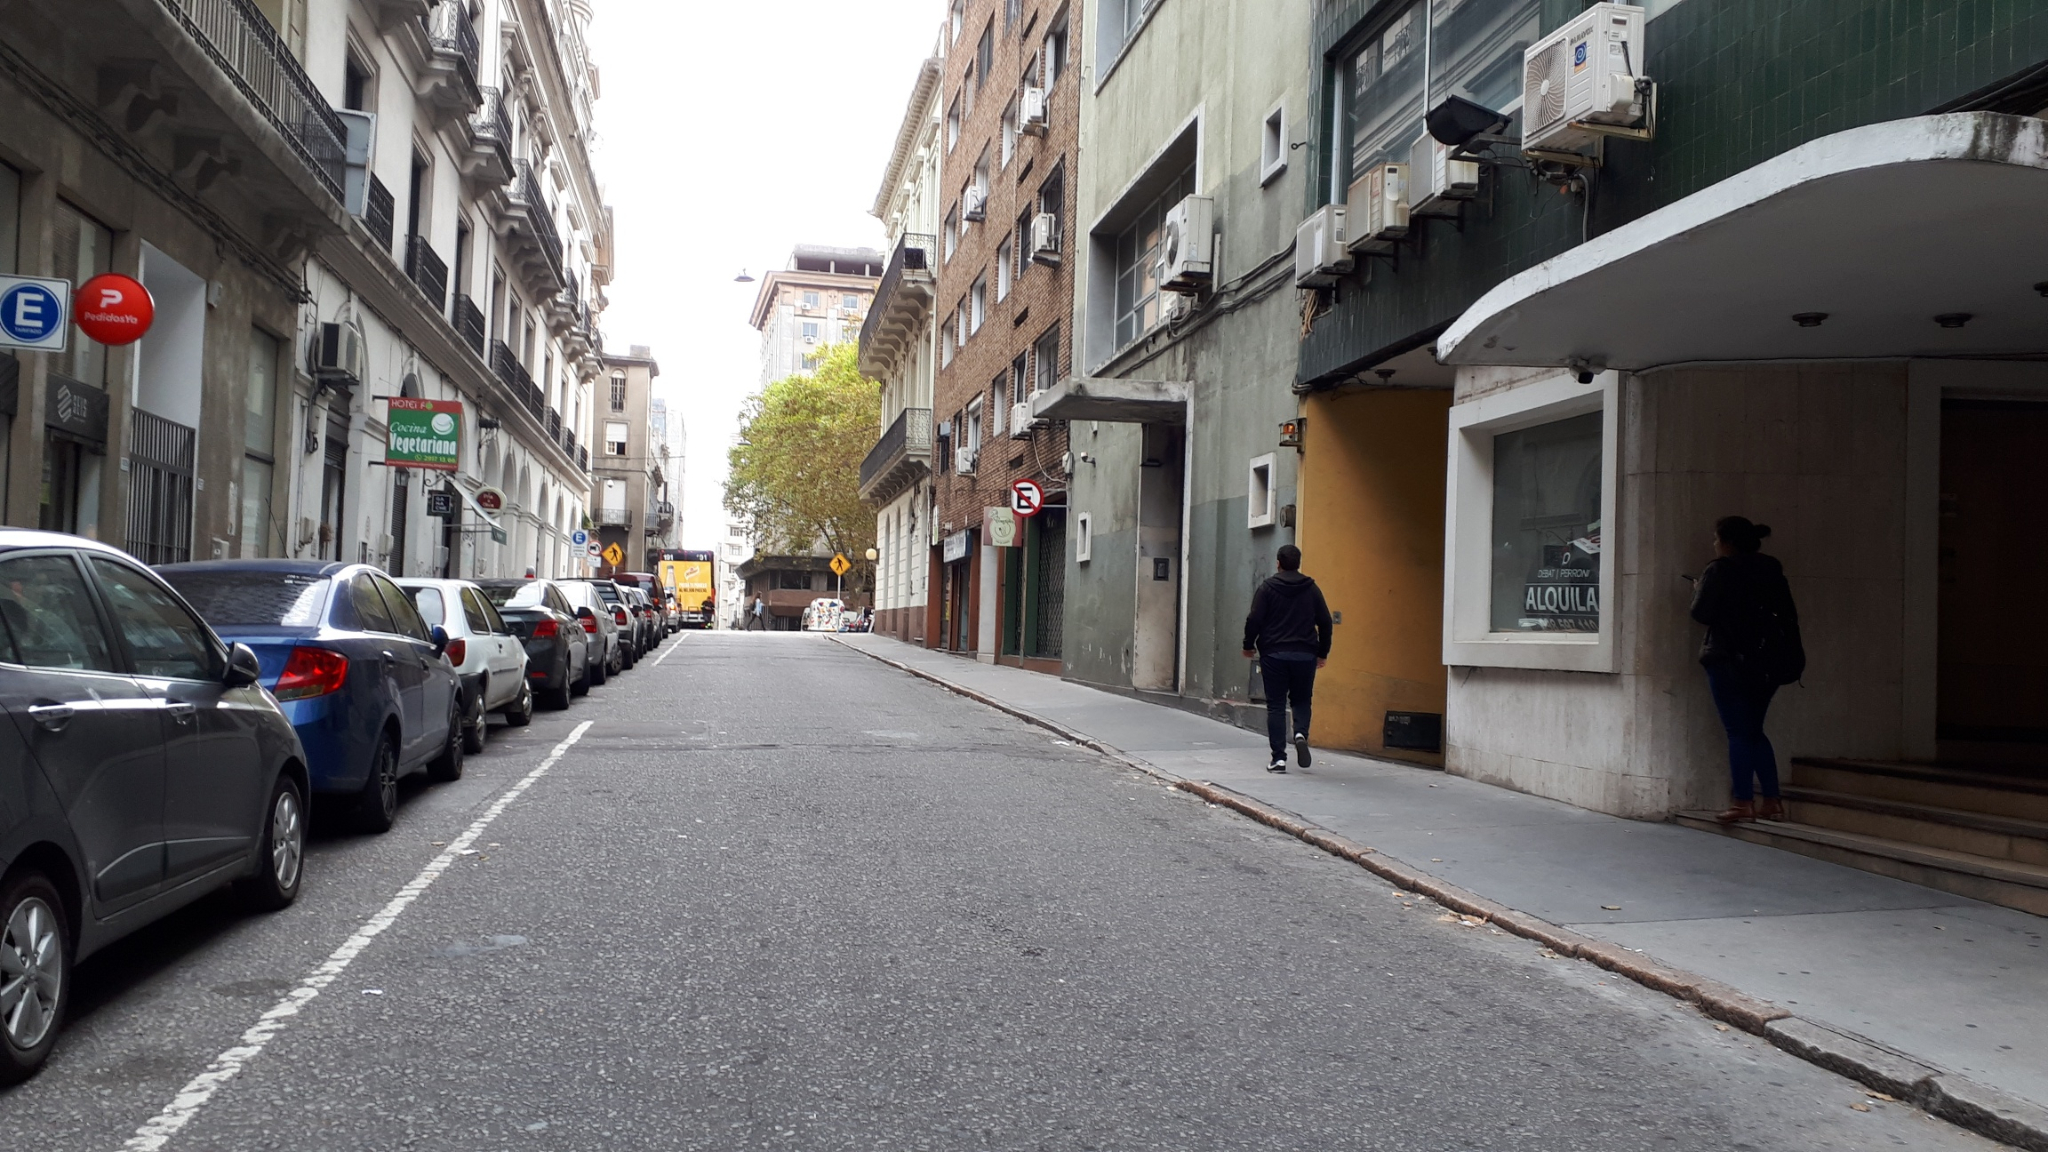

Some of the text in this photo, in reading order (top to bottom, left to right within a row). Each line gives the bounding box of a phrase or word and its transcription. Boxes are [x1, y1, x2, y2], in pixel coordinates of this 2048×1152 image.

[100, 289, 123, 308] P
[15, 292, 44, 328] E
[84, 311, 138, 325] PedidosYa
[389, 421, 427, 434] Cocina
[389, 432, 456, 455] Vegetariana
[1017, 487, 1033, 509] E
[575, 533, 583, 543] E
[1537, 569, 1590, 578] DEBAT PERRONI
[1525, 586, 1600, 614] ALQUILA
